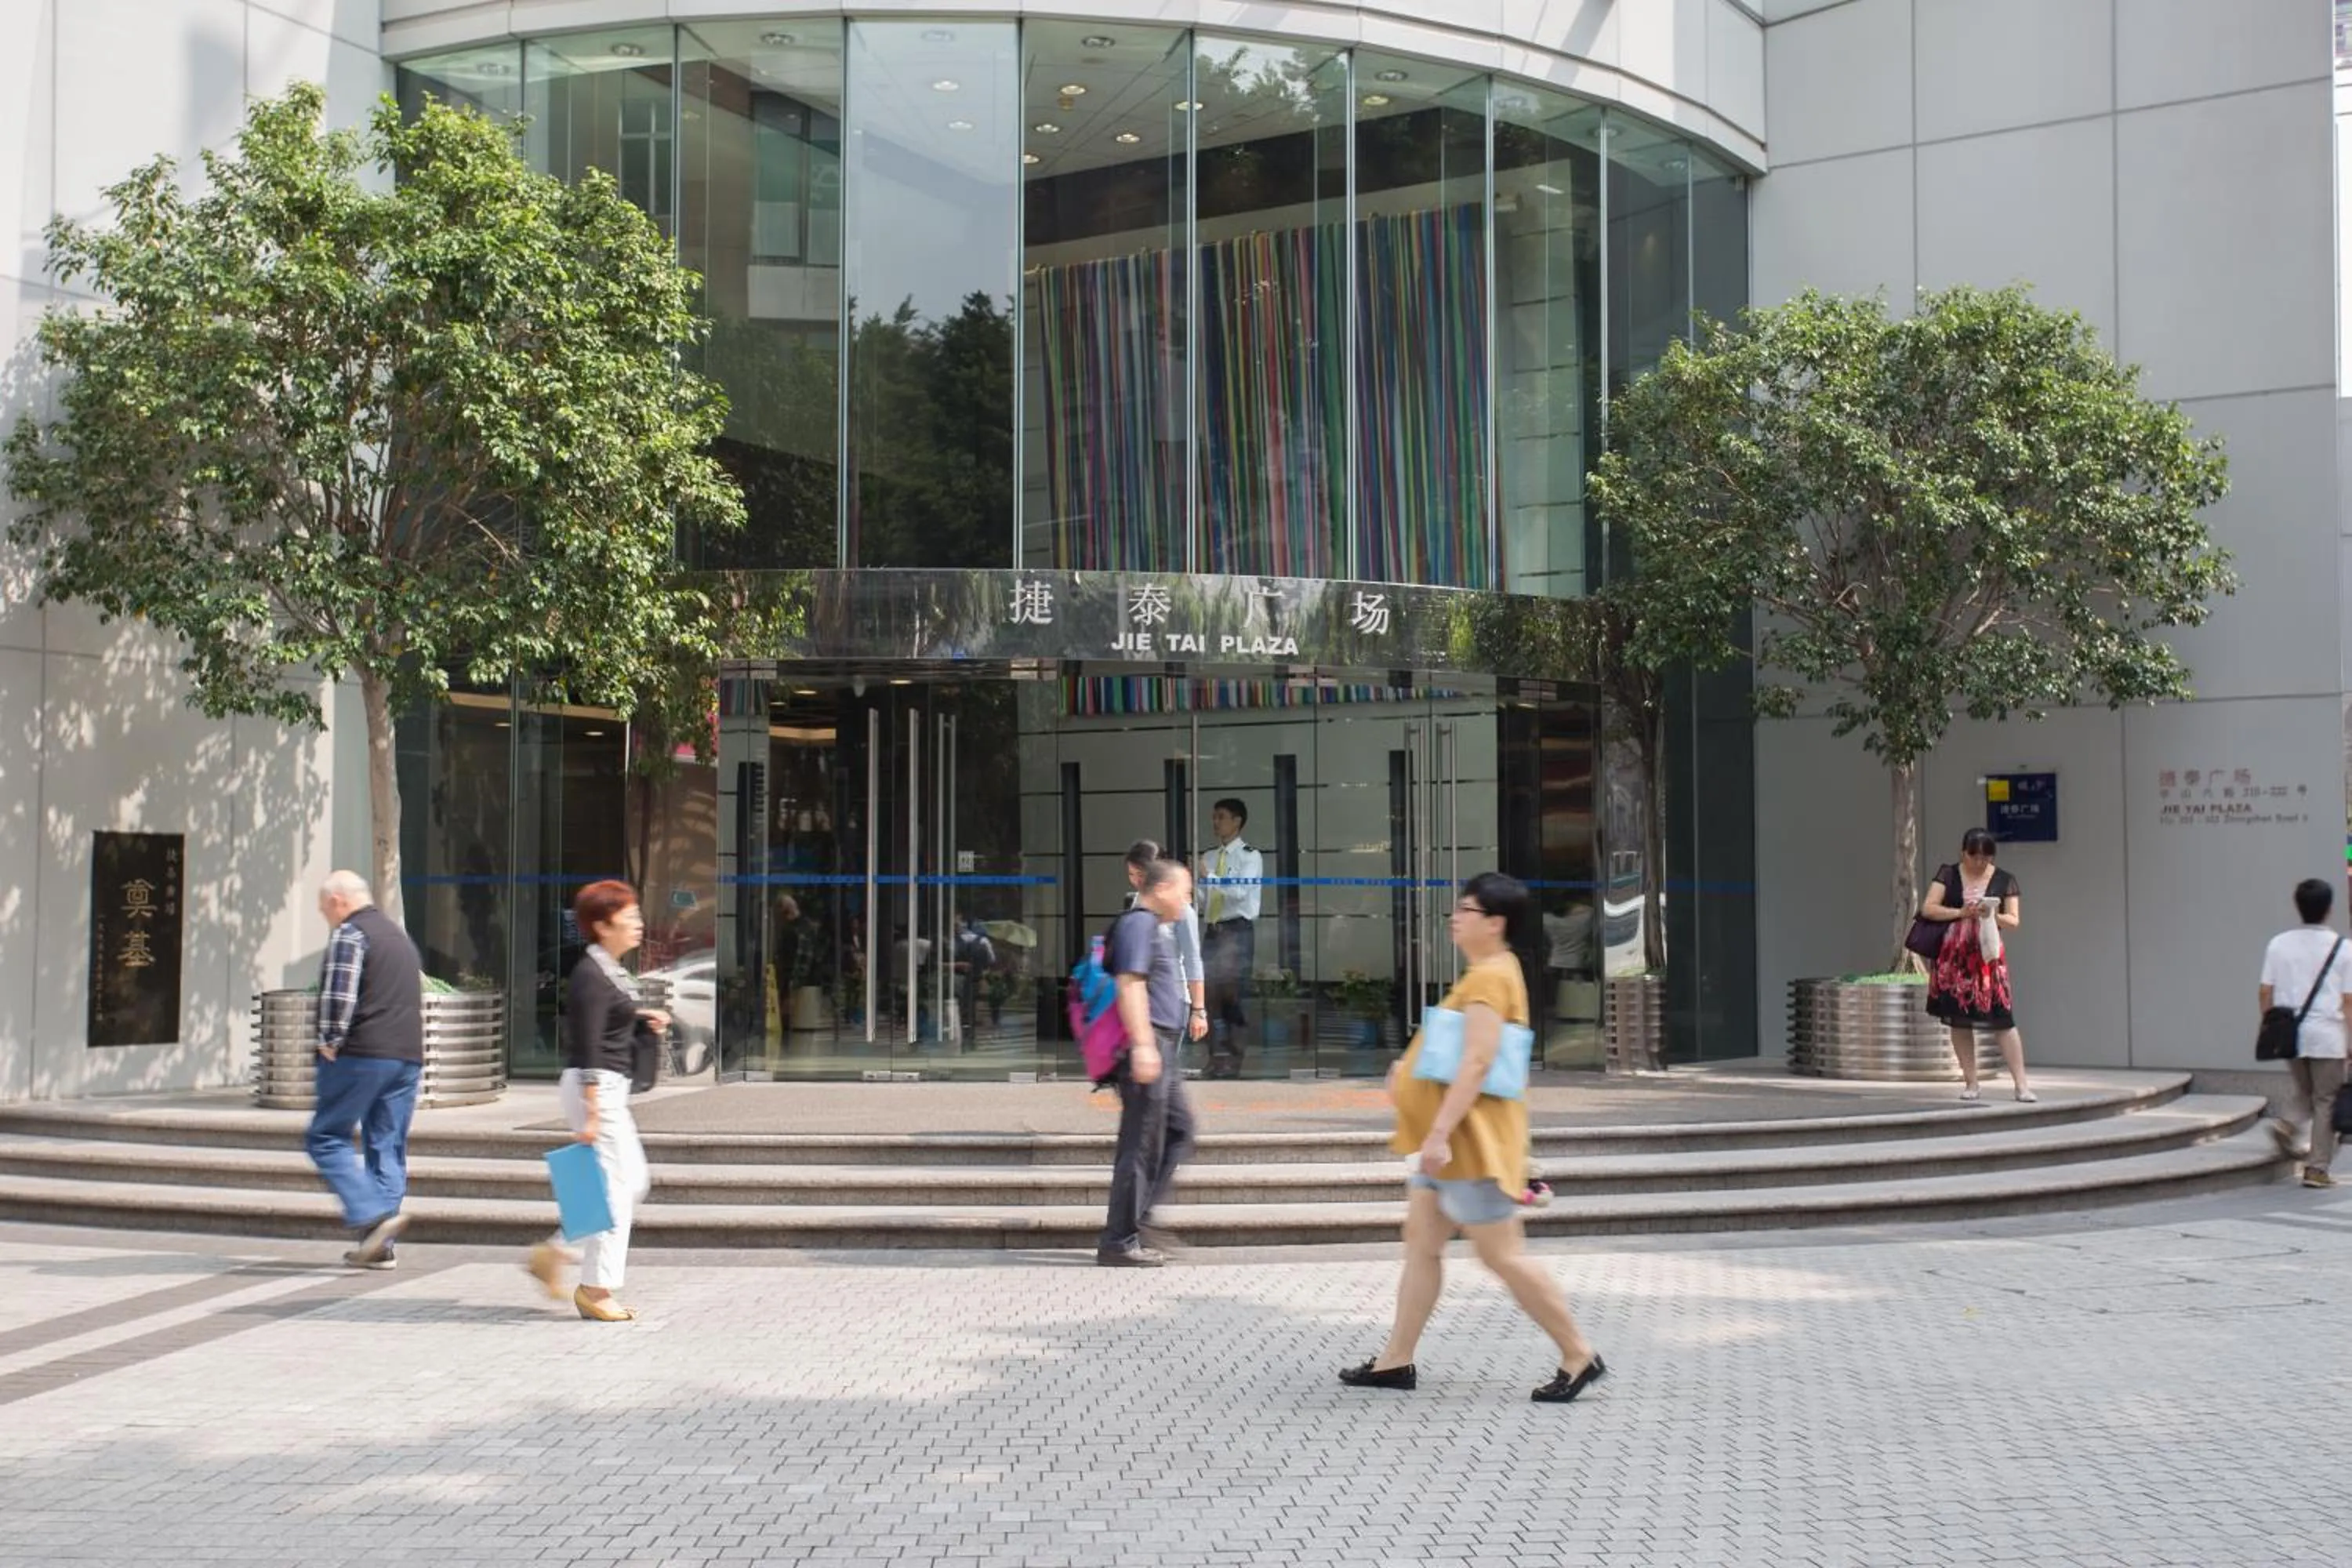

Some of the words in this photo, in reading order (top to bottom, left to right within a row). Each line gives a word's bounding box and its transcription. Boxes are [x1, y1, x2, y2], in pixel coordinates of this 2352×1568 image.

[1009, 579, 1390, 635] 捷泰广场
[1110, 631, 1152, 650] JIE
[1166, 633, 1205, 652] TAI
[1220, 635, 1299, 655] PLAZA
[118, 877, 158, 967] 奠基
